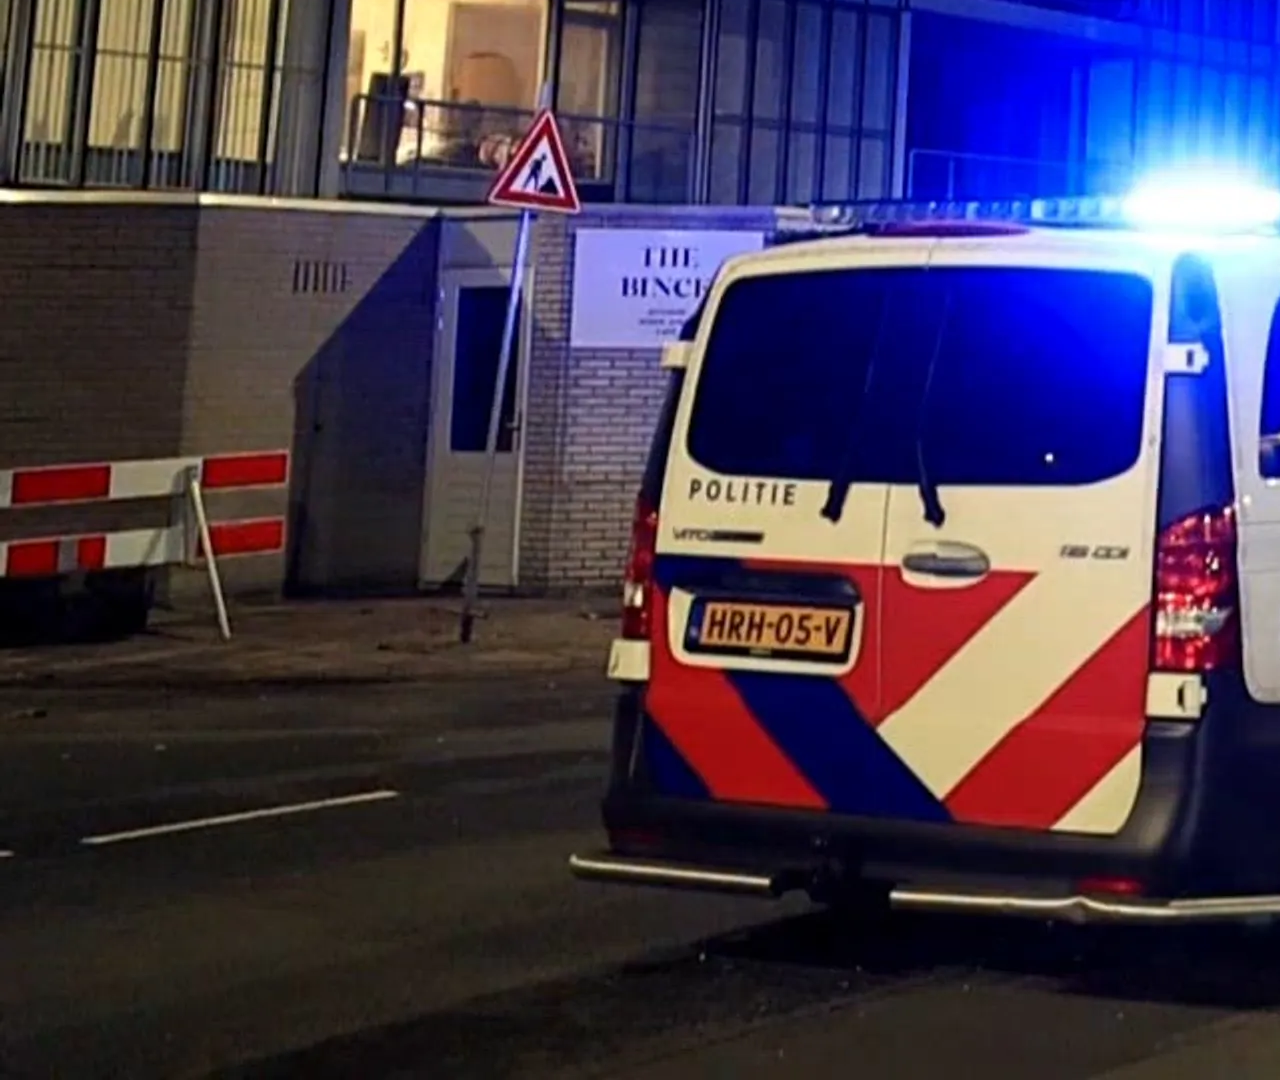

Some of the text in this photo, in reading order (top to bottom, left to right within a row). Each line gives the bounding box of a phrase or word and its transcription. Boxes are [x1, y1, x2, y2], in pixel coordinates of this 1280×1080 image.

[639, 246, 700, 268] THE
[688, 478, 797, 506] POLITIE
[706, 608, 841, 647] HRH-05-V
